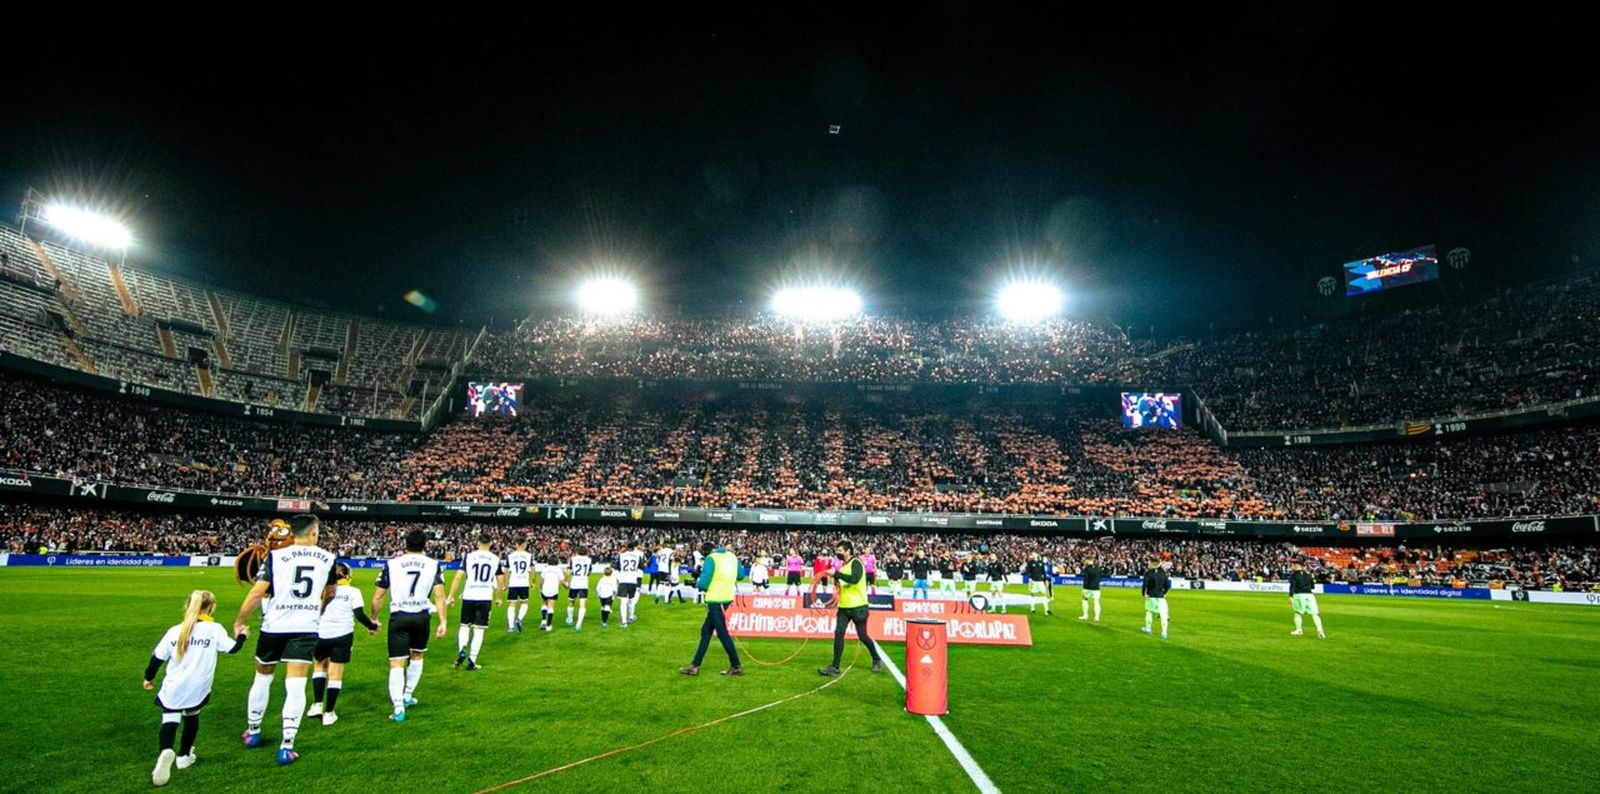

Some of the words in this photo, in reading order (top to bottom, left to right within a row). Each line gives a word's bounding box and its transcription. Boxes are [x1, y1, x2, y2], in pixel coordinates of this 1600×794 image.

[131, 385, 150, 397] 1949
[256, 407, 274, 417] 1954
[1445, 422, 1466, 433] 1999
[1294, 436, 1311, 444] 1999
[147, 490, 176, 503] Coca-Cola
[496, 507, 521, 517] Coca-Cola
[1142, 520, 1168, 530] Coca-Cola
[1511, 520, 1545, 533] Coca-Cola
[107, 558, 142, 566] identidad
[142, 558, 164, 568] digital
[292, 550, 329, 563] PAULISTA
[472, 562, 492, 582] 10
[513, 560, 527, 574] 19
[574, 563, 588, 577] 21
[622, 559, 637, 572] 23
[290, 565, 315, 600] 5
[407, 570, 421, 598] 7
[1401, 587, 1439, 596] identidad
[1440, 589, 1463, 598] digital
[170, 636, 211, 649] vling
